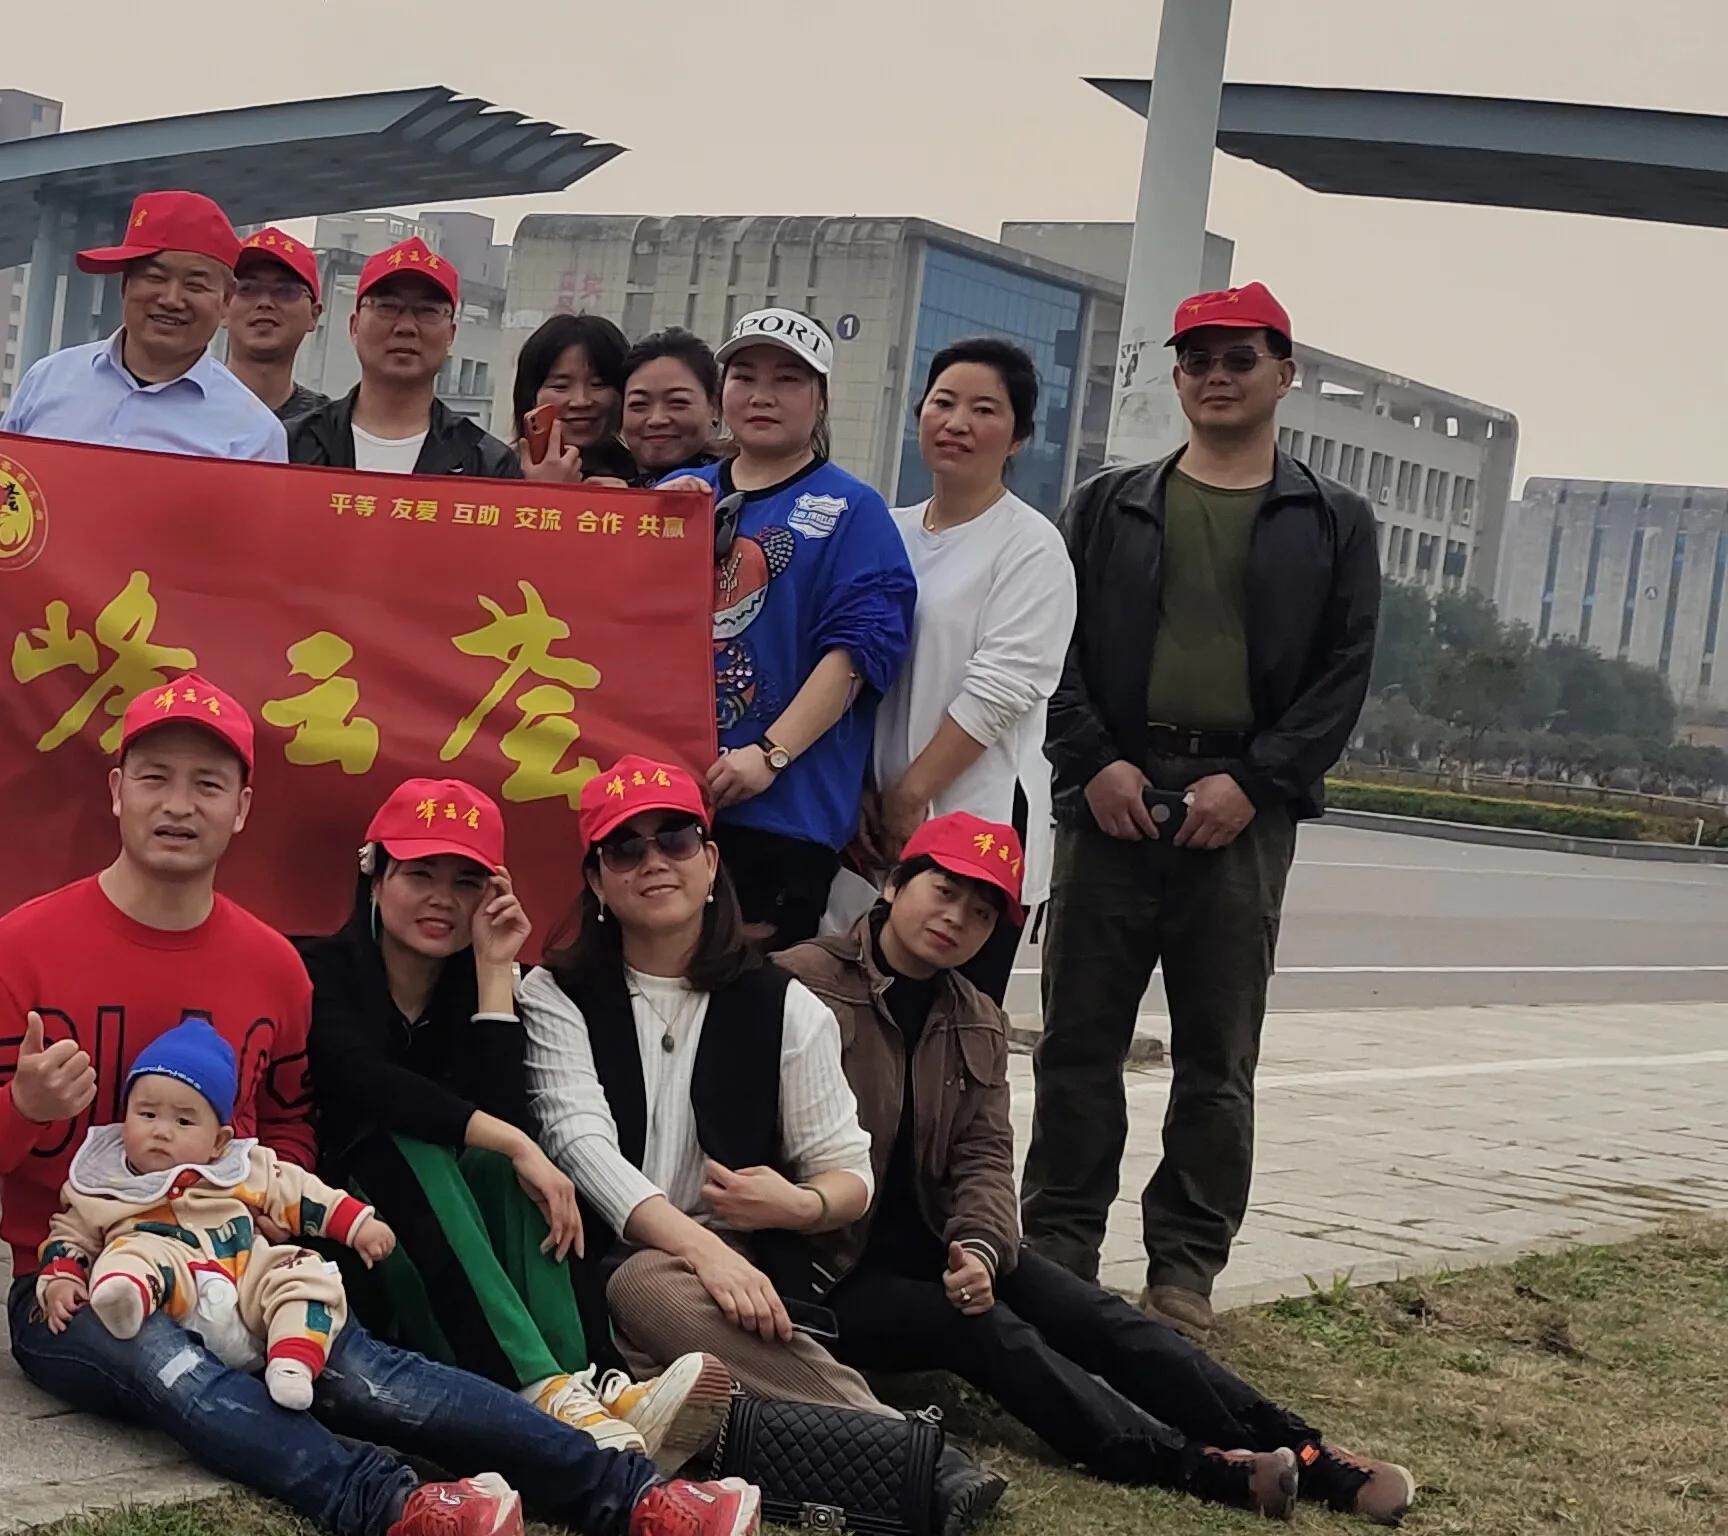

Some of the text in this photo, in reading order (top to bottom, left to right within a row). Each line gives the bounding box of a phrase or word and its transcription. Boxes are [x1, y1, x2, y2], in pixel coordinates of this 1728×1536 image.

[733, 315, 827, 355] PORT
[329, 492, 686, 539] 平等 友爱 互助 交流 合作 共赢
